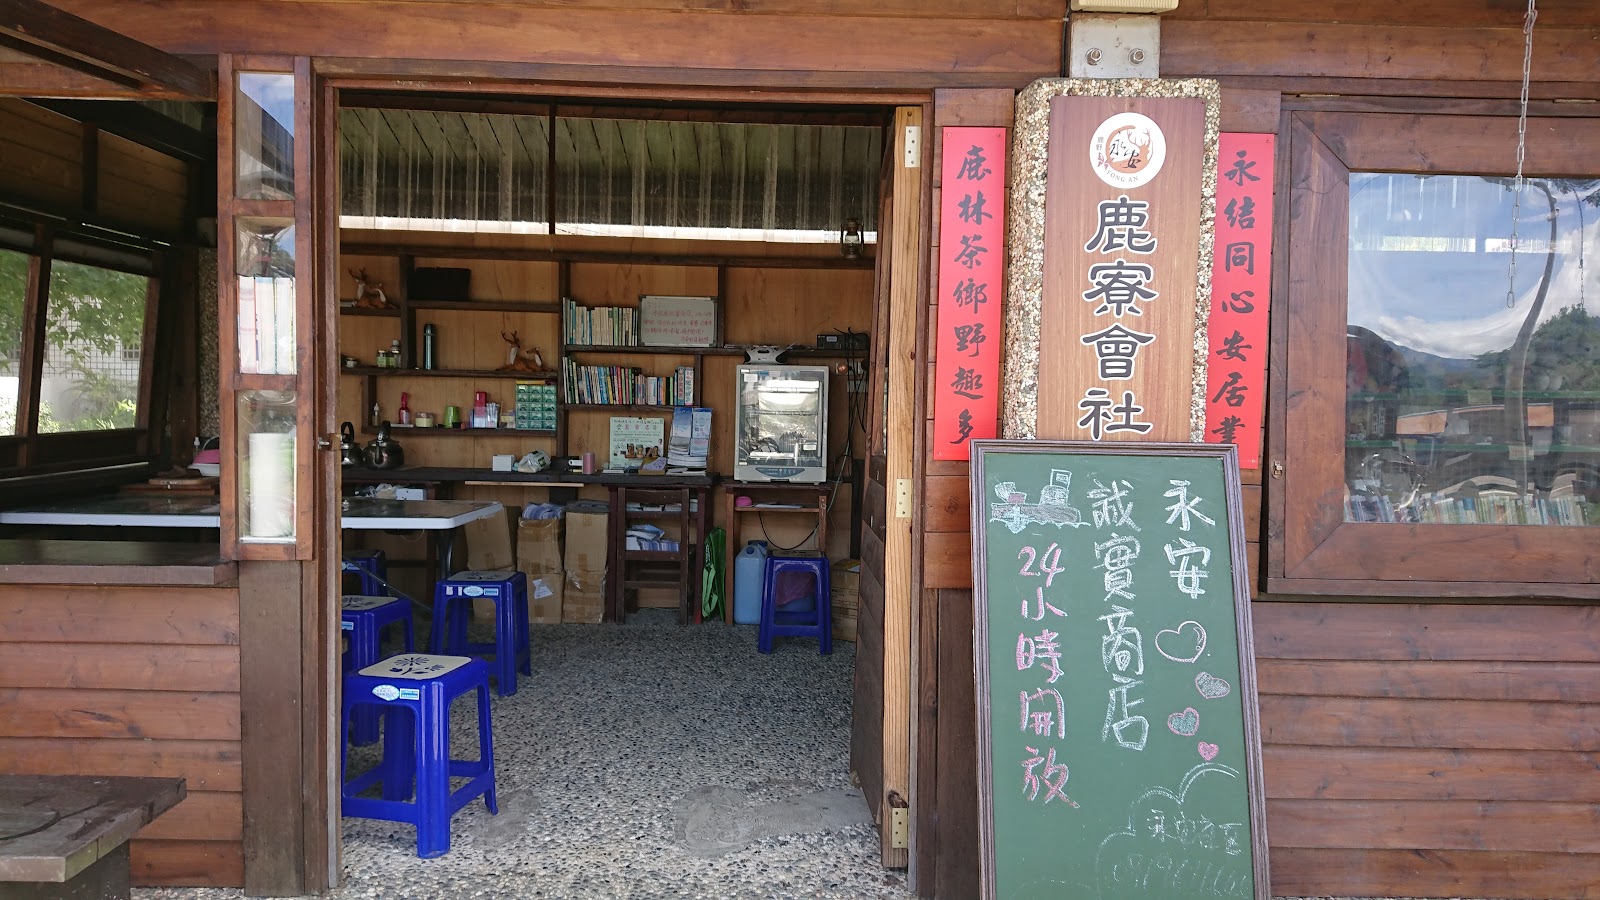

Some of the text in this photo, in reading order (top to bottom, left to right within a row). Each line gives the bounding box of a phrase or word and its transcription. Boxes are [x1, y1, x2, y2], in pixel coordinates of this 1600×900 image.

[1078, 195, 1159, 440] 鹿寮會社
[1211, 151, 1261, 443] 永結同心安居業
[1086, 479, 1150, 752] 誠實商店
[1163, 479, 1216, 600] 永安
